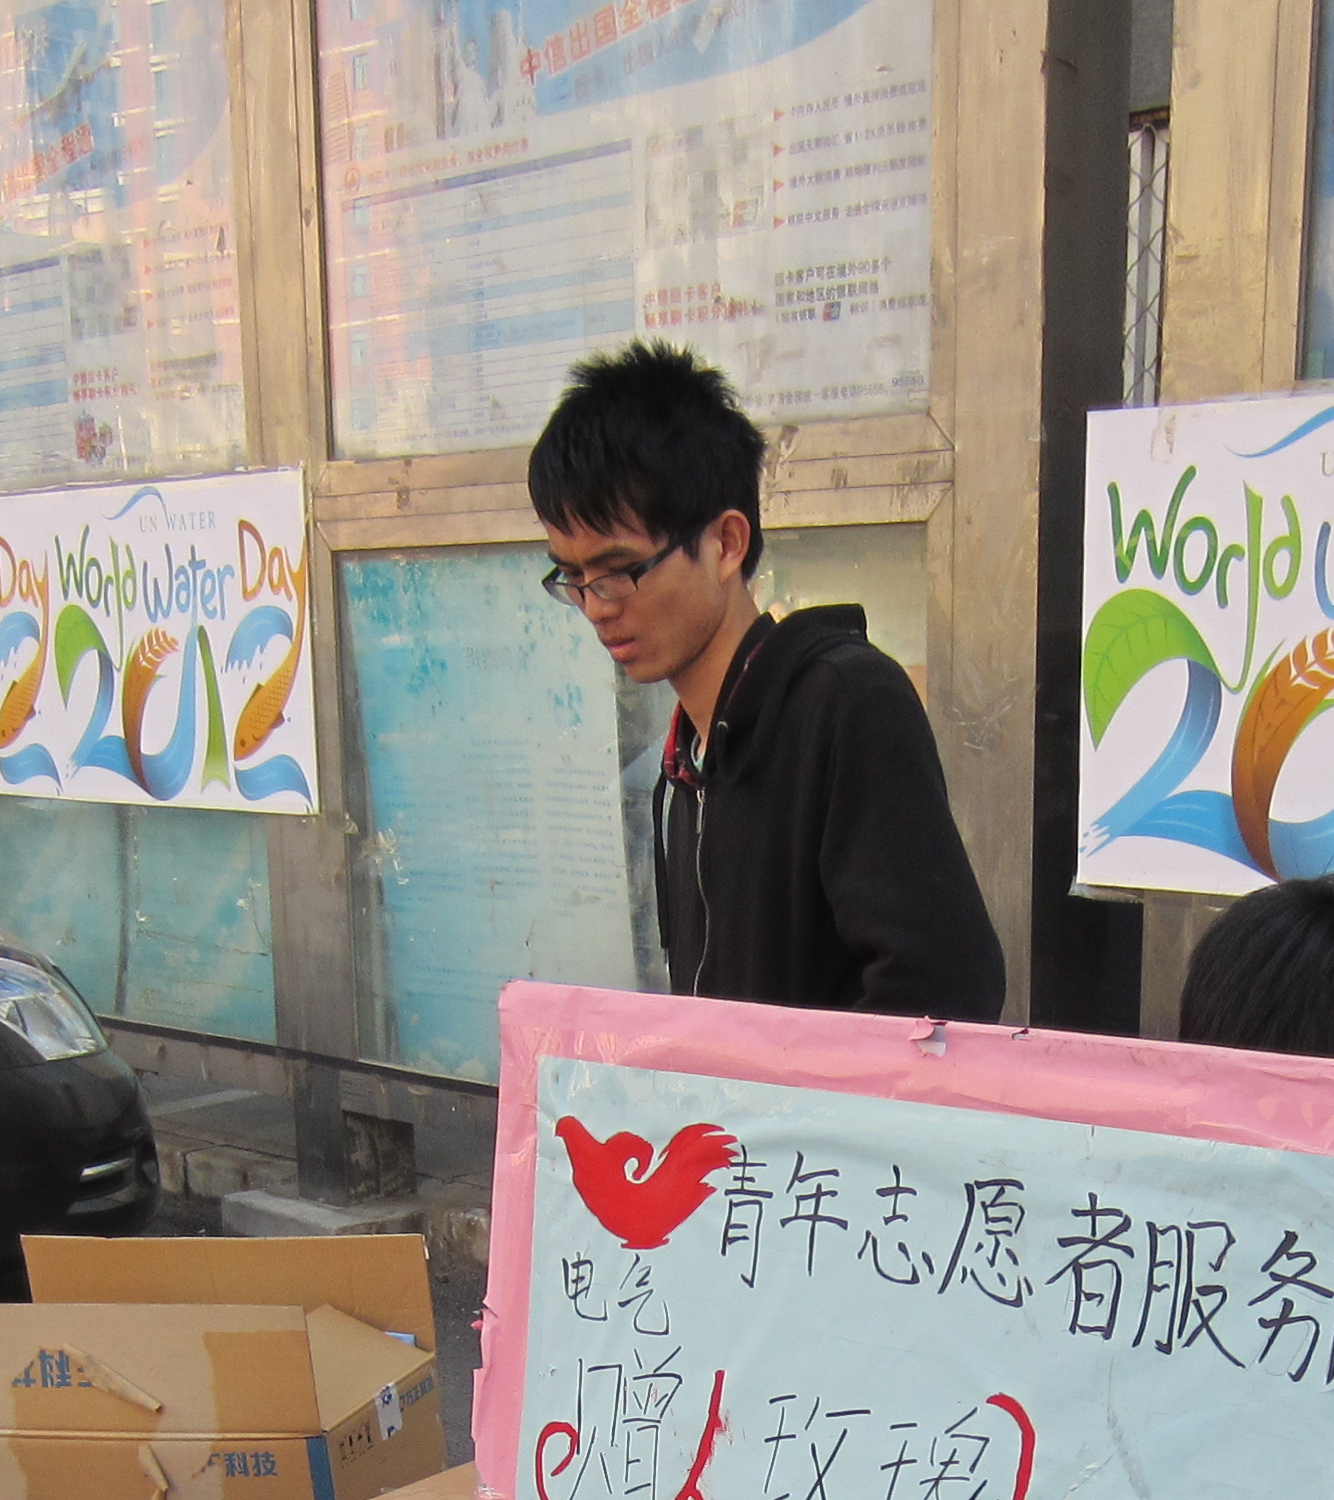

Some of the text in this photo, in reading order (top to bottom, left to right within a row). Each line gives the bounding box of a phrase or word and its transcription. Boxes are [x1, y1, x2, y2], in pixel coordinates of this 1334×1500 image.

[139, 511, 216, 533] UN WATER
[1107, 465, 1302, 694] World
[54, 518, 307, 671] World Water Day
[559, 1250, 673, 1338] 电气
